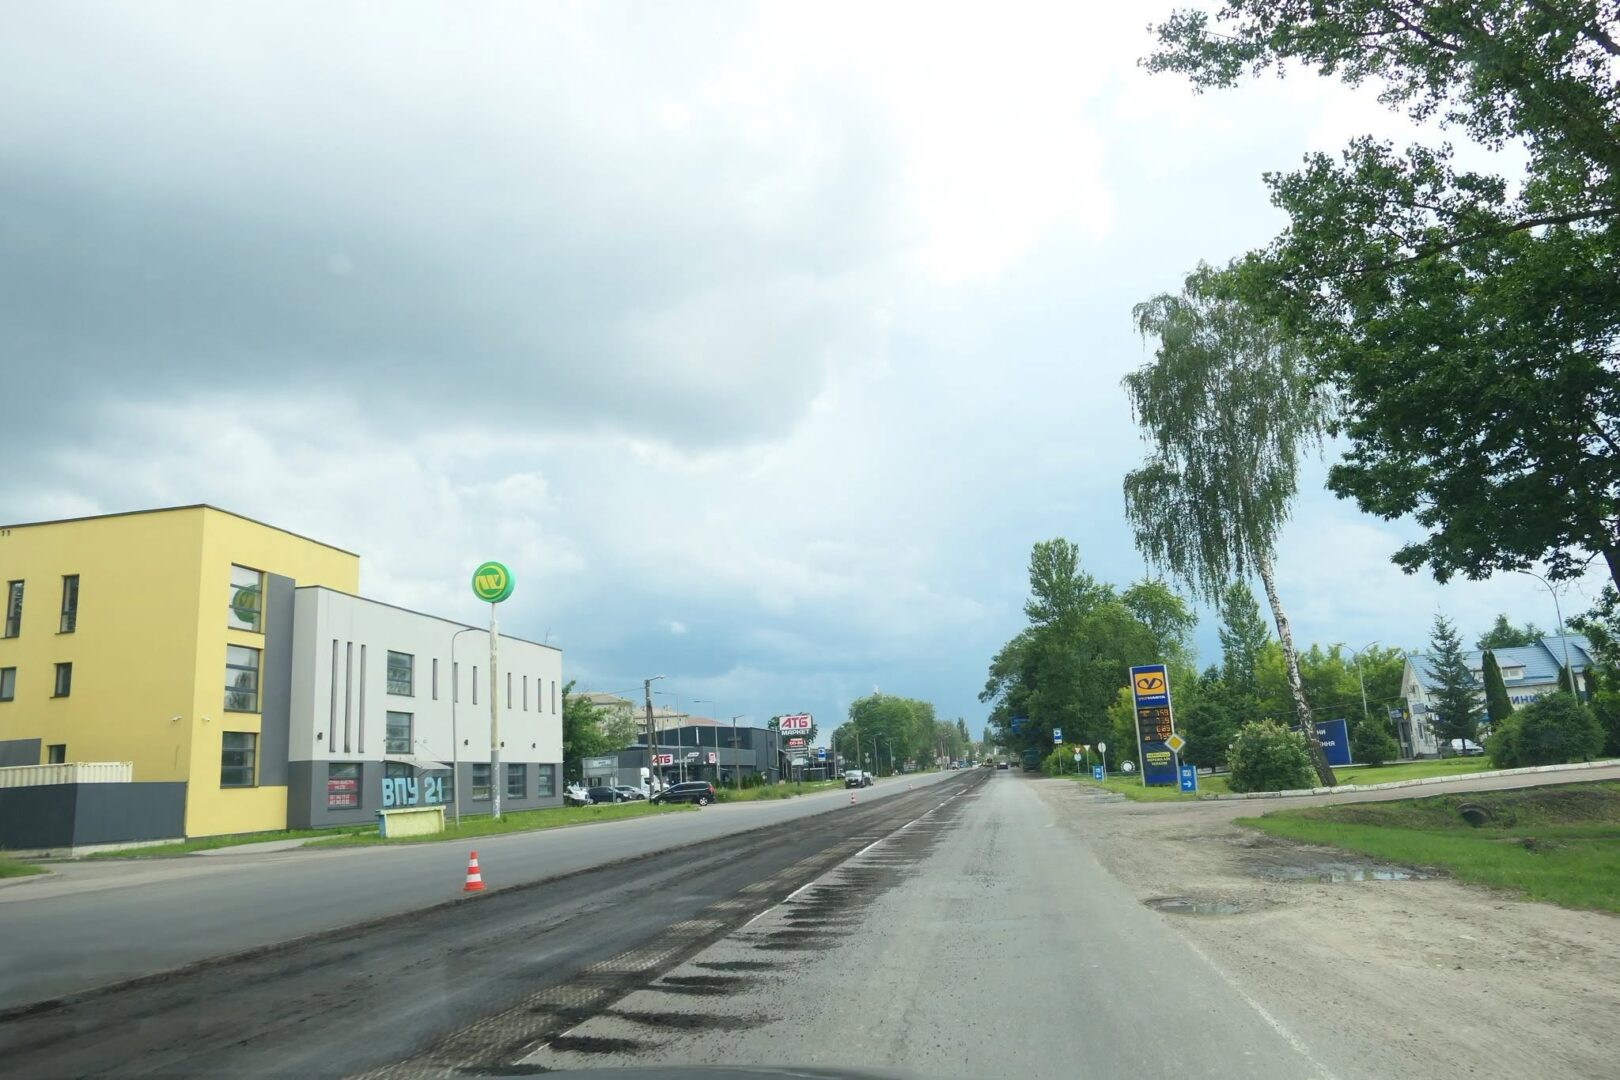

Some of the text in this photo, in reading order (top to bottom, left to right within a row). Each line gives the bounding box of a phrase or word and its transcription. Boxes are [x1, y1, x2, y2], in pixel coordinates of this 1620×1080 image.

[782, 716, 808, 728] АТБ
[381, 777, 443, 807] ВПУ 21
